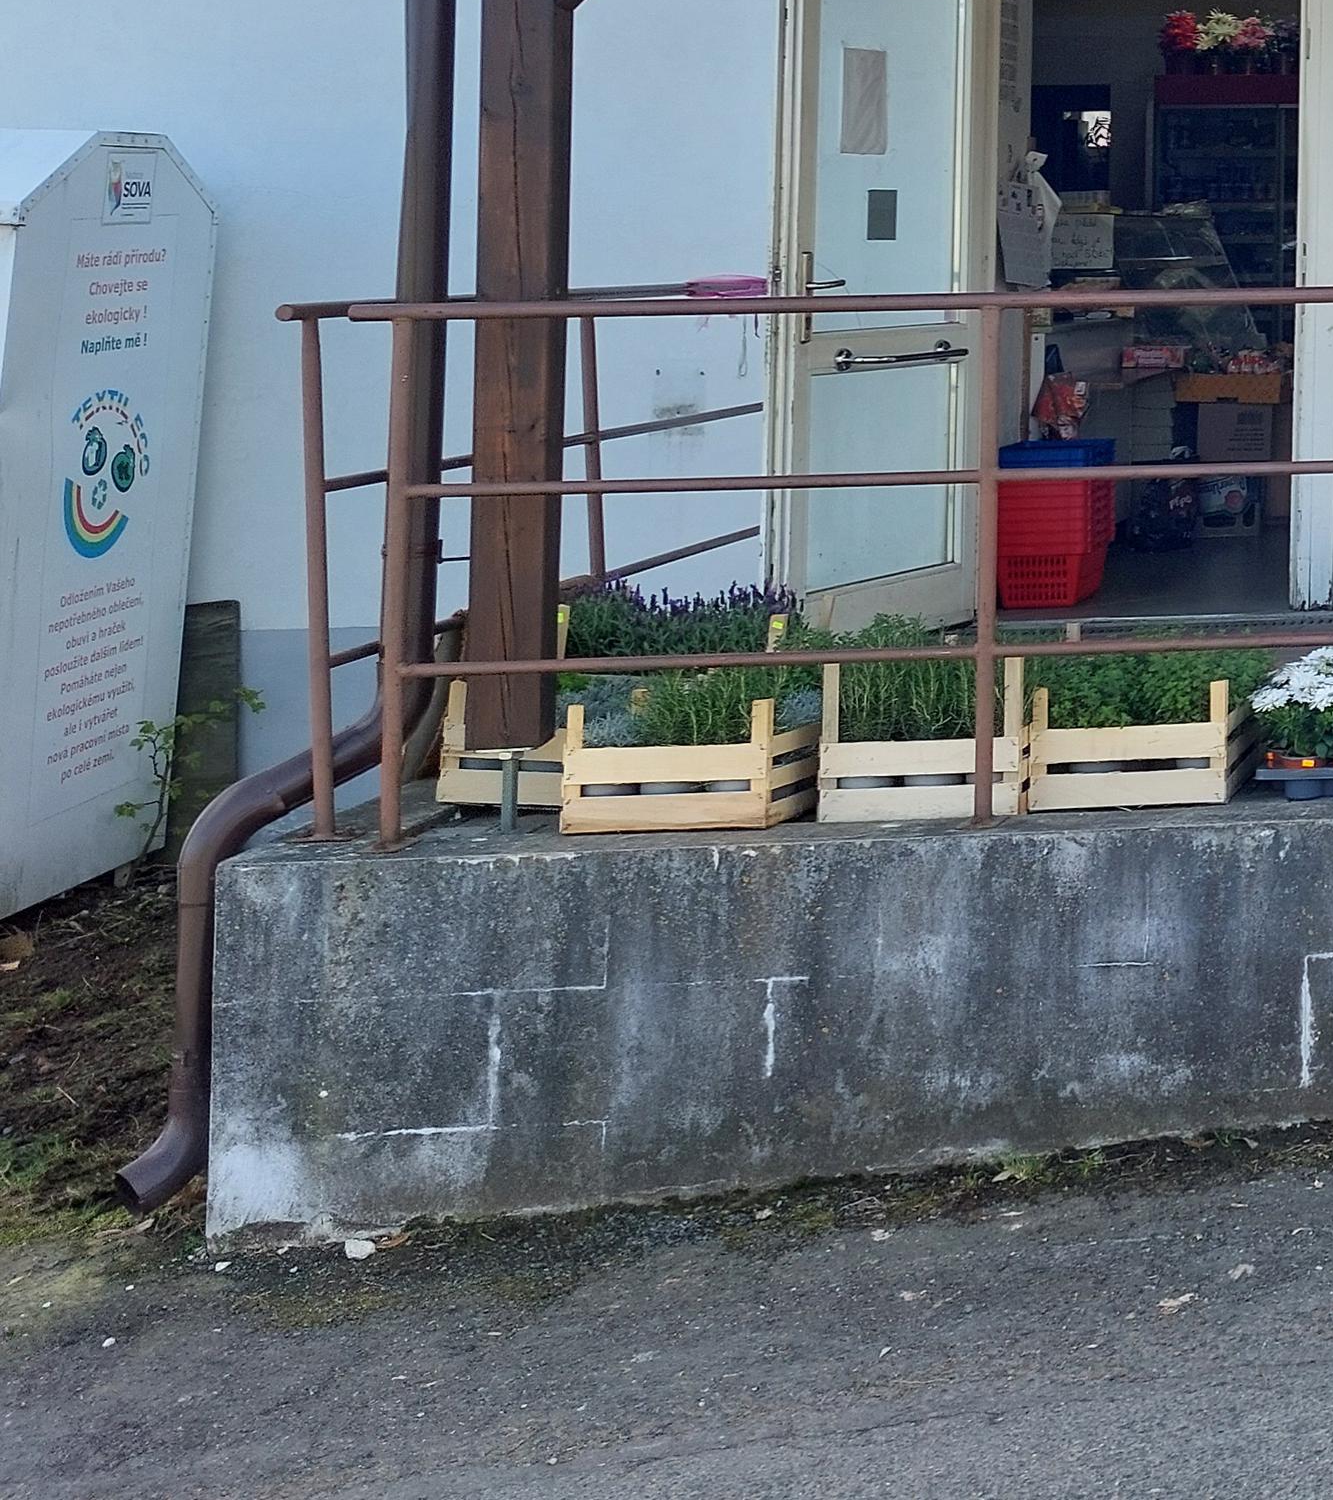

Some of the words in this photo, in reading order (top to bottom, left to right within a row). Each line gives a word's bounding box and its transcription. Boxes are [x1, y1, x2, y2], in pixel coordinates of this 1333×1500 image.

[123, 181, 151, 197] SOVA
[76, 252, 100, 268] Máte
[102, 250, 121, 267] rádi
[124, 248, 167, 268] přírodu?
[89, 278, 133, 297] Chovejte
[136, 280, 149, 292] se
[85, 306, 140, 325] ekologicky
[81, 335, 121, 355] Naplňte
[124, 332, 141, 349] mě
[106, 577, 136, 594] Vašeho
[65, 631, 90, 650] obuvi
[91, 631, 97, 642] a
[98, 620, 126, 639] hraček
[104, 663, 127, 680] nejen
[47, 692, 105, 722] ekologickému
[63, 723, 77, 737] ale
[70, 730, 106, 759] pracovní
[107, 723, 130, 741] místa
[60, 768, 72, 785] po
[73, 757, 91, 776] celé
